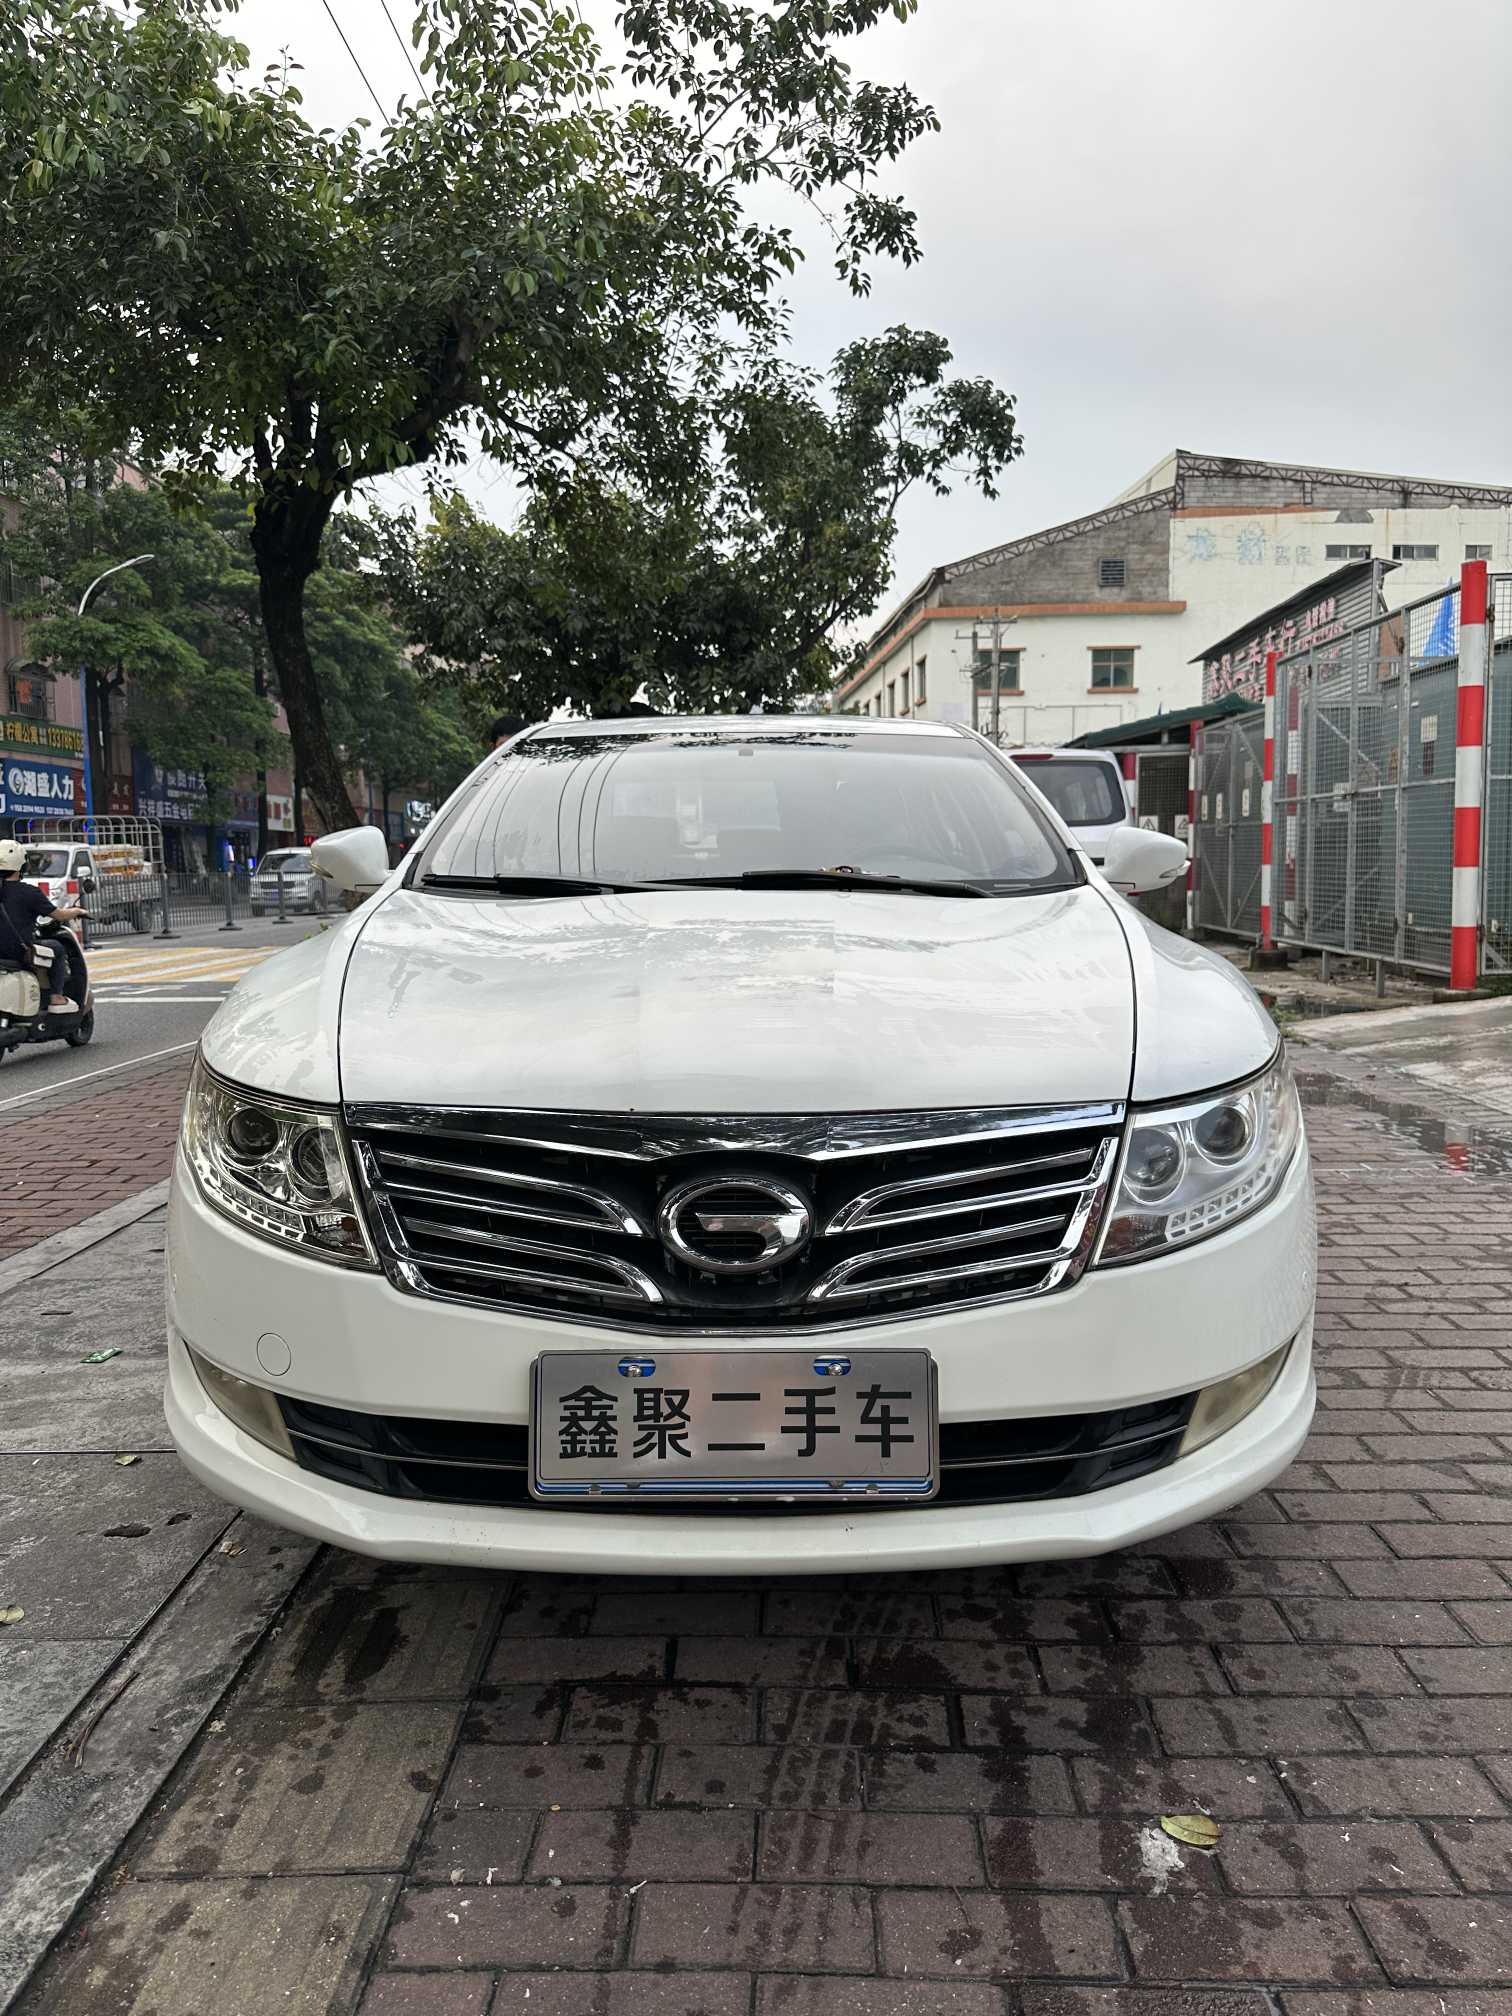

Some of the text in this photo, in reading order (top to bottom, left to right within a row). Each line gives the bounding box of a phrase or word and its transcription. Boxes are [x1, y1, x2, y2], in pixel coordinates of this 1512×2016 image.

[558, 1383, 915, 1460] 鑫聚二手车
